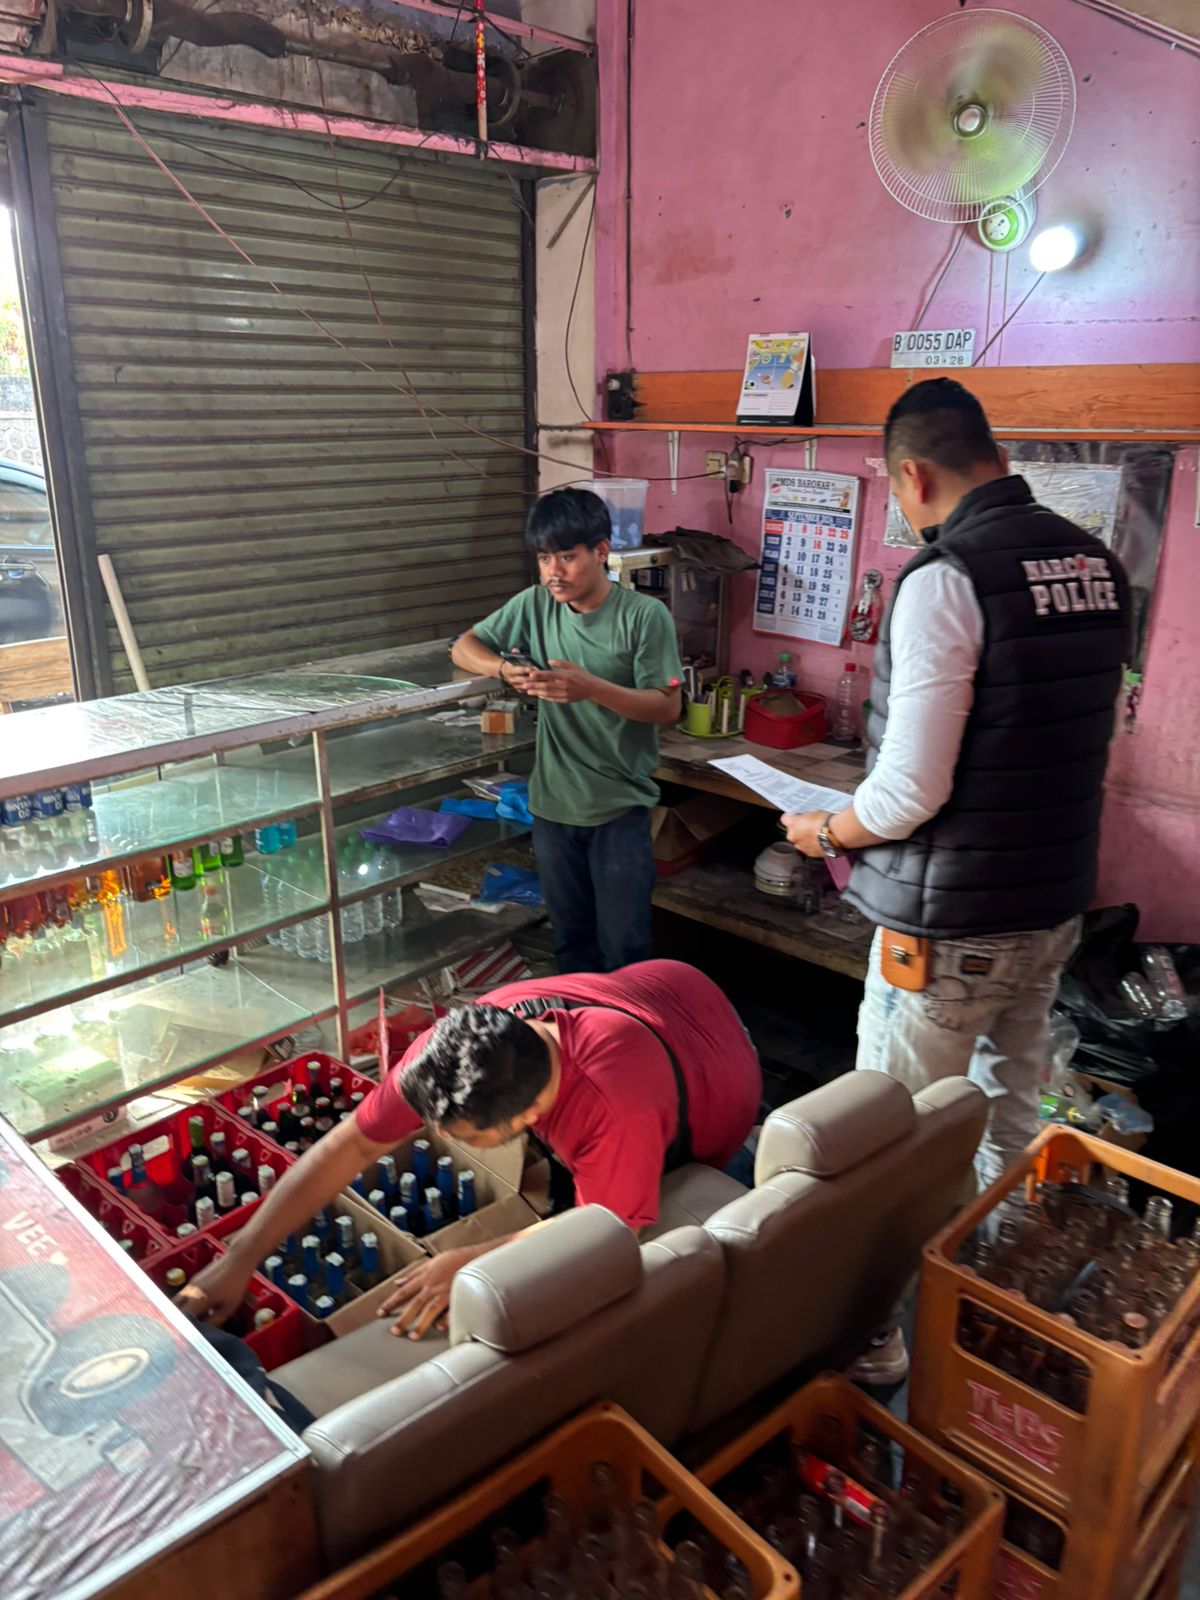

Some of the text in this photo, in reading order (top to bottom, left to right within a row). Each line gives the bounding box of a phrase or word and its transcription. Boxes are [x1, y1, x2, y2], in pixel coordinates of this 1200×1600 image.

[893, 334, 902, 351] B
[945, 331, 972, 350] DAP
[1029, 581, 1119, 616] POLICE
